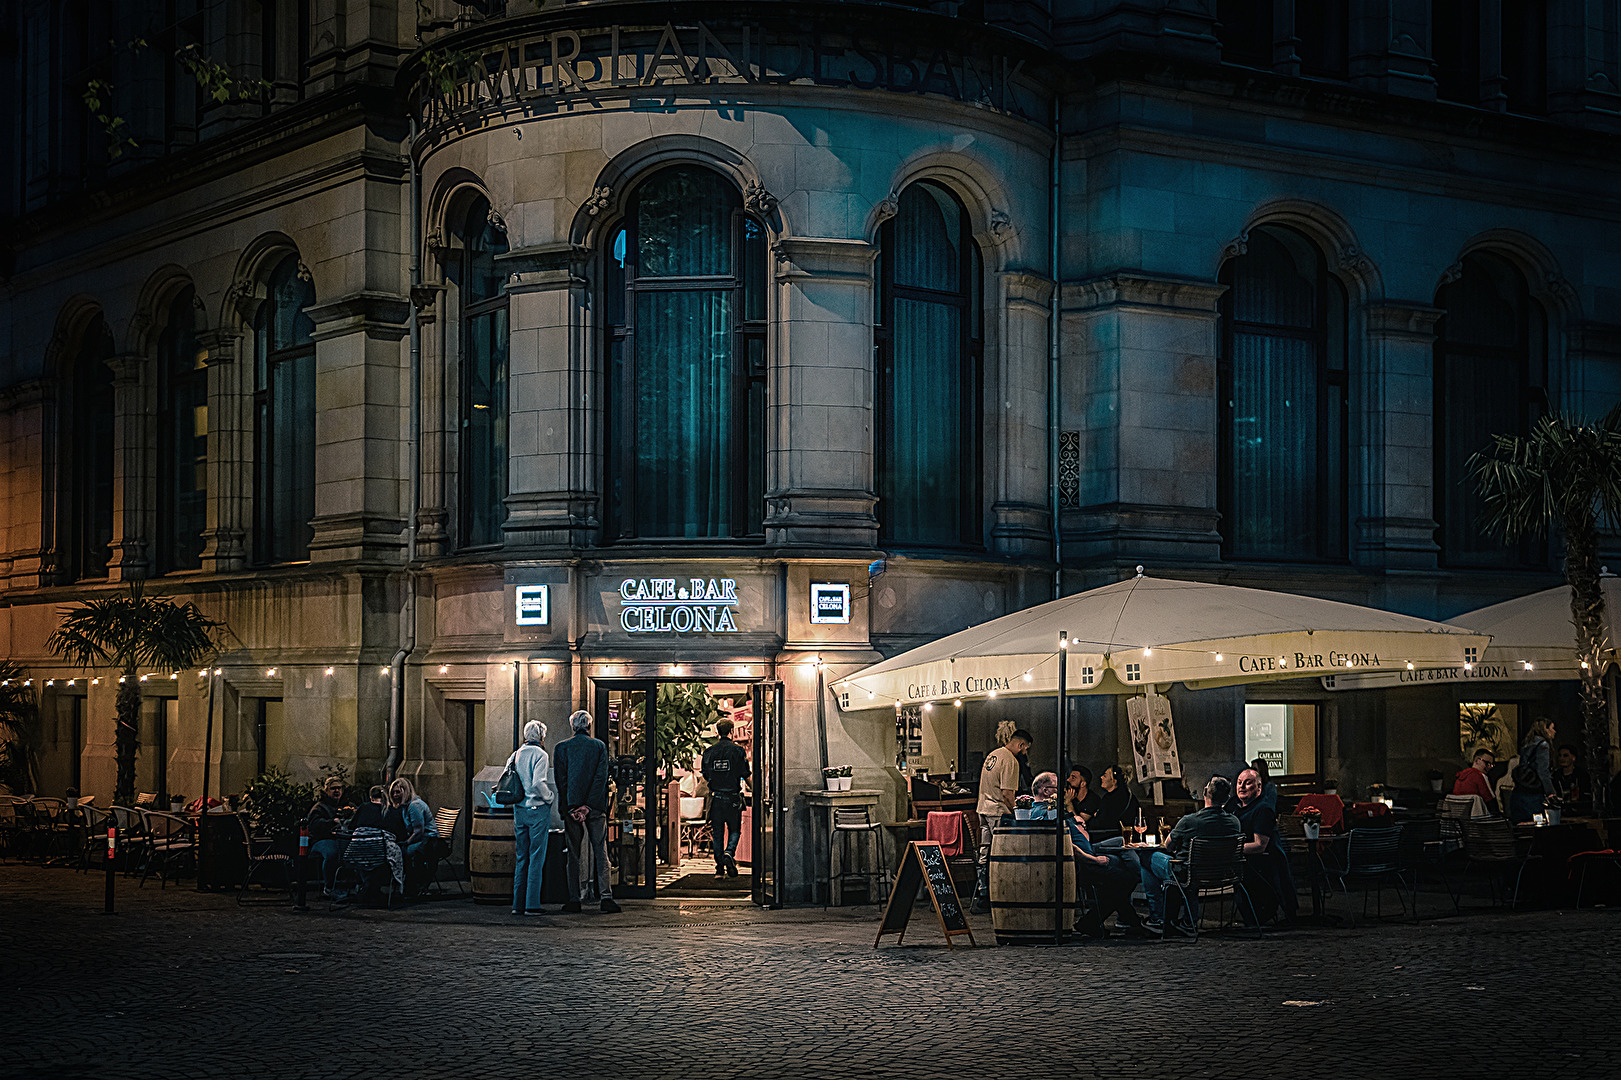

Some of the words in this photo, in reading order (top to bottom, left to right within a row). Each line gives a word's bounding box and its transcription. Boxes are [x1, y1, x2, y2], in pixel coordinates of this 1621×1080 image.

[611, 20, 1028, 119] LANDESBANK
[620, 578, 676, 600] CAFE
[678, 587, 690, 600] &
[690, 578, 738, 600] BAR
[620, 606, 738, 633] CELONA
[1239, 656, 1276, 673] CAFE
[1294, 652, 1324, 668] BAR
[1329, 650, 1381, 667] CELONA
[1399, 668, 1424, 683] CAFE
[1427, 669, 1434, 680] &
[1436, 668, 1458, 679] BAR
[1463, 665, 1509, 678] CELONA
[908, 683, 931, 699] CAFE
[931, 684, 937, 696] &
[941, 679, 961, 695] BAR
[965, 676, 1010, 692] CELONA
[1267, 760, 1282, 768] LONA
